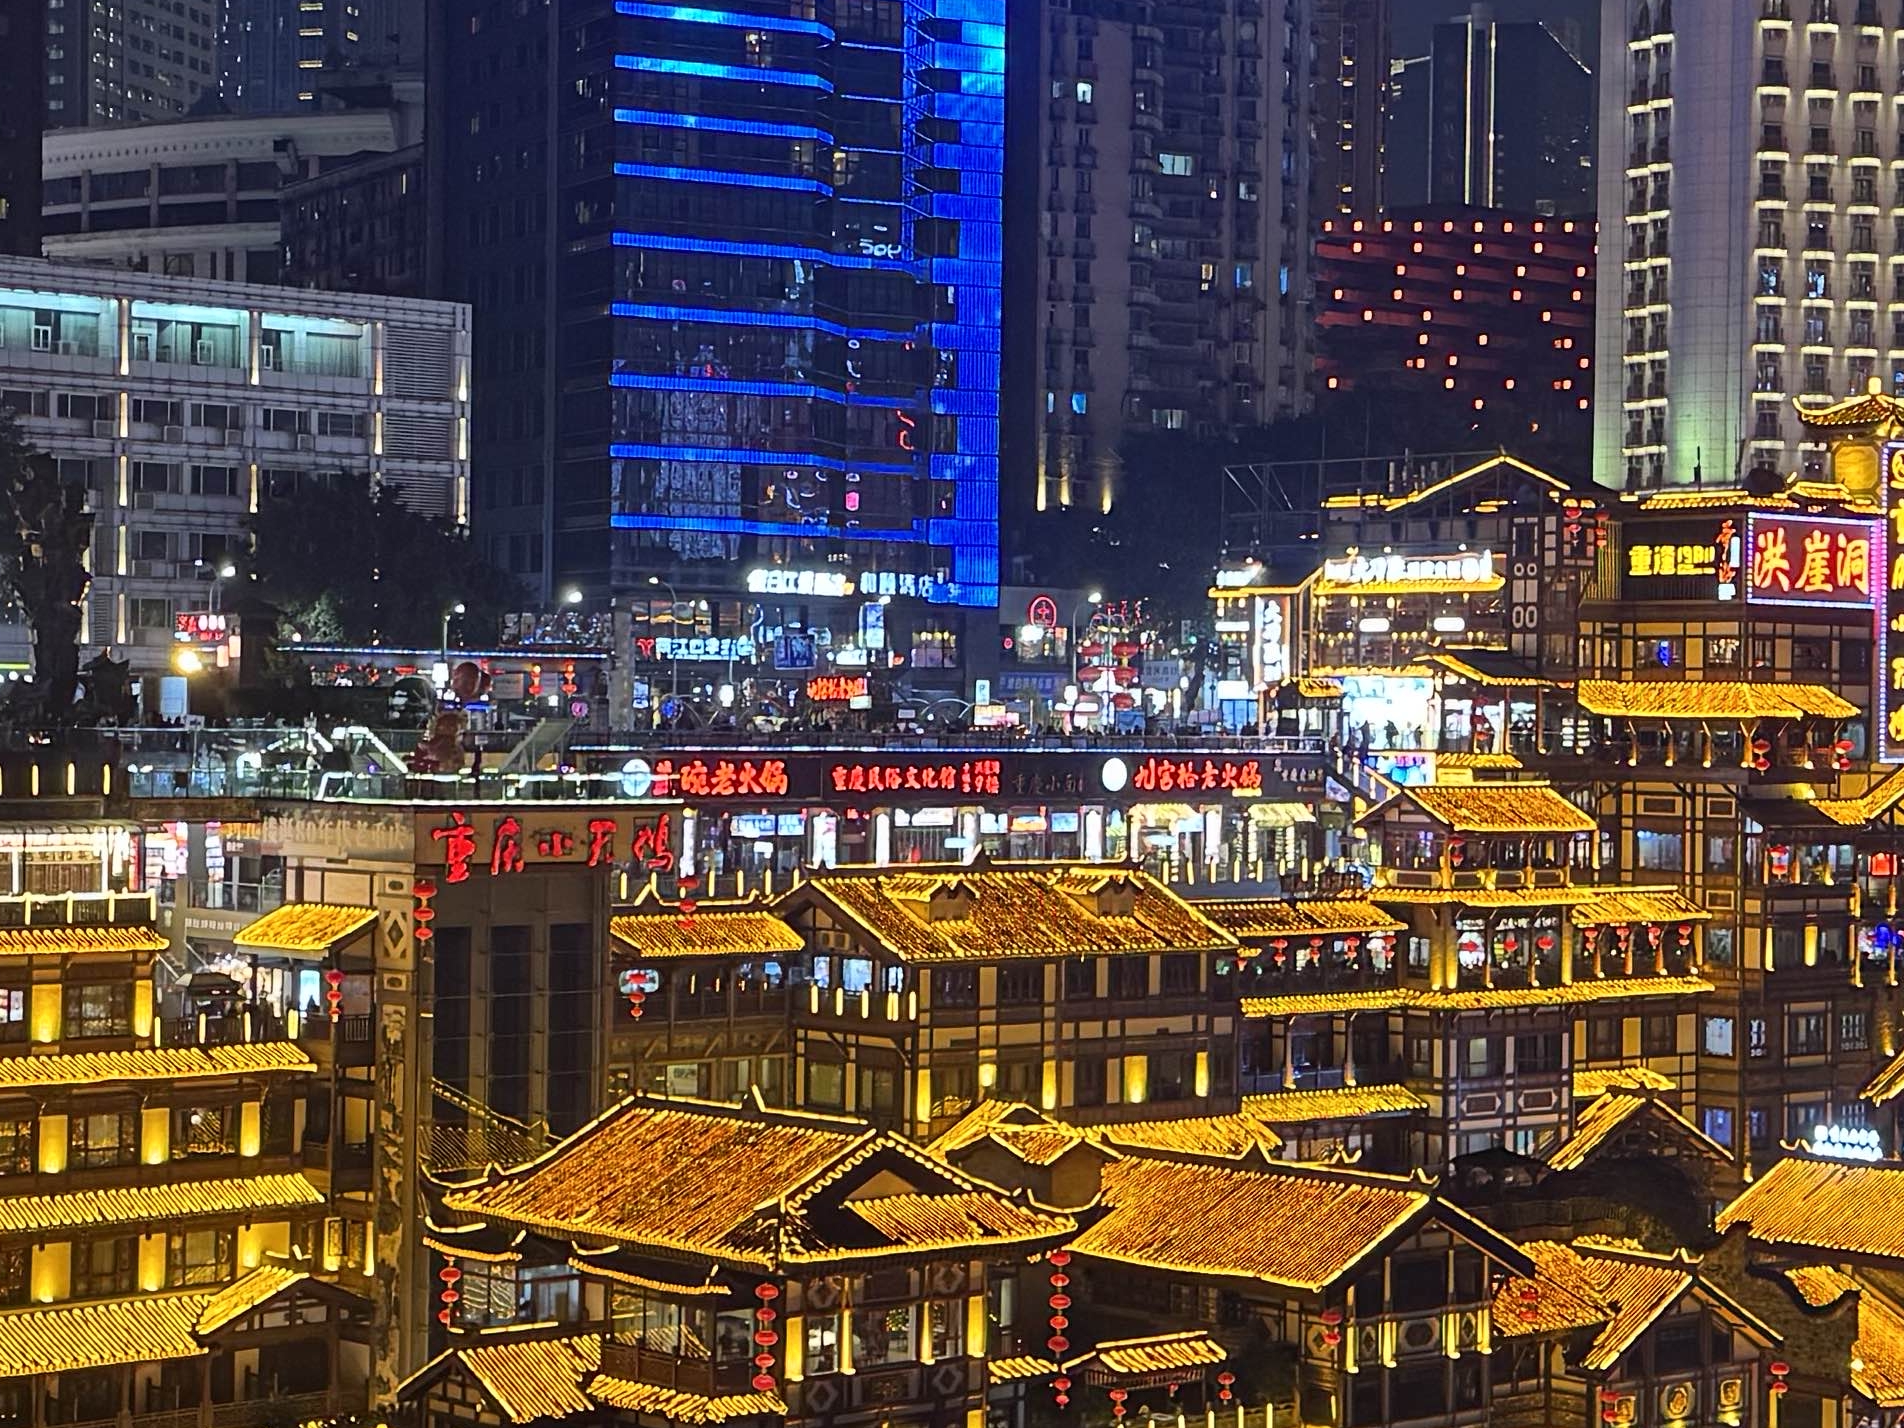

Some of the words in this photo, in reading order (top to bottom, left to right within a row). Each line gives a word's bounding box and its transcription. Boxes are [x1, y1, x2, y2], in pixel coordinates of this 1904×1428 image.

[1754, 527, 1870, 596] 洪崖洞
[431, 811, 675, 884] 重庆小天鹅
